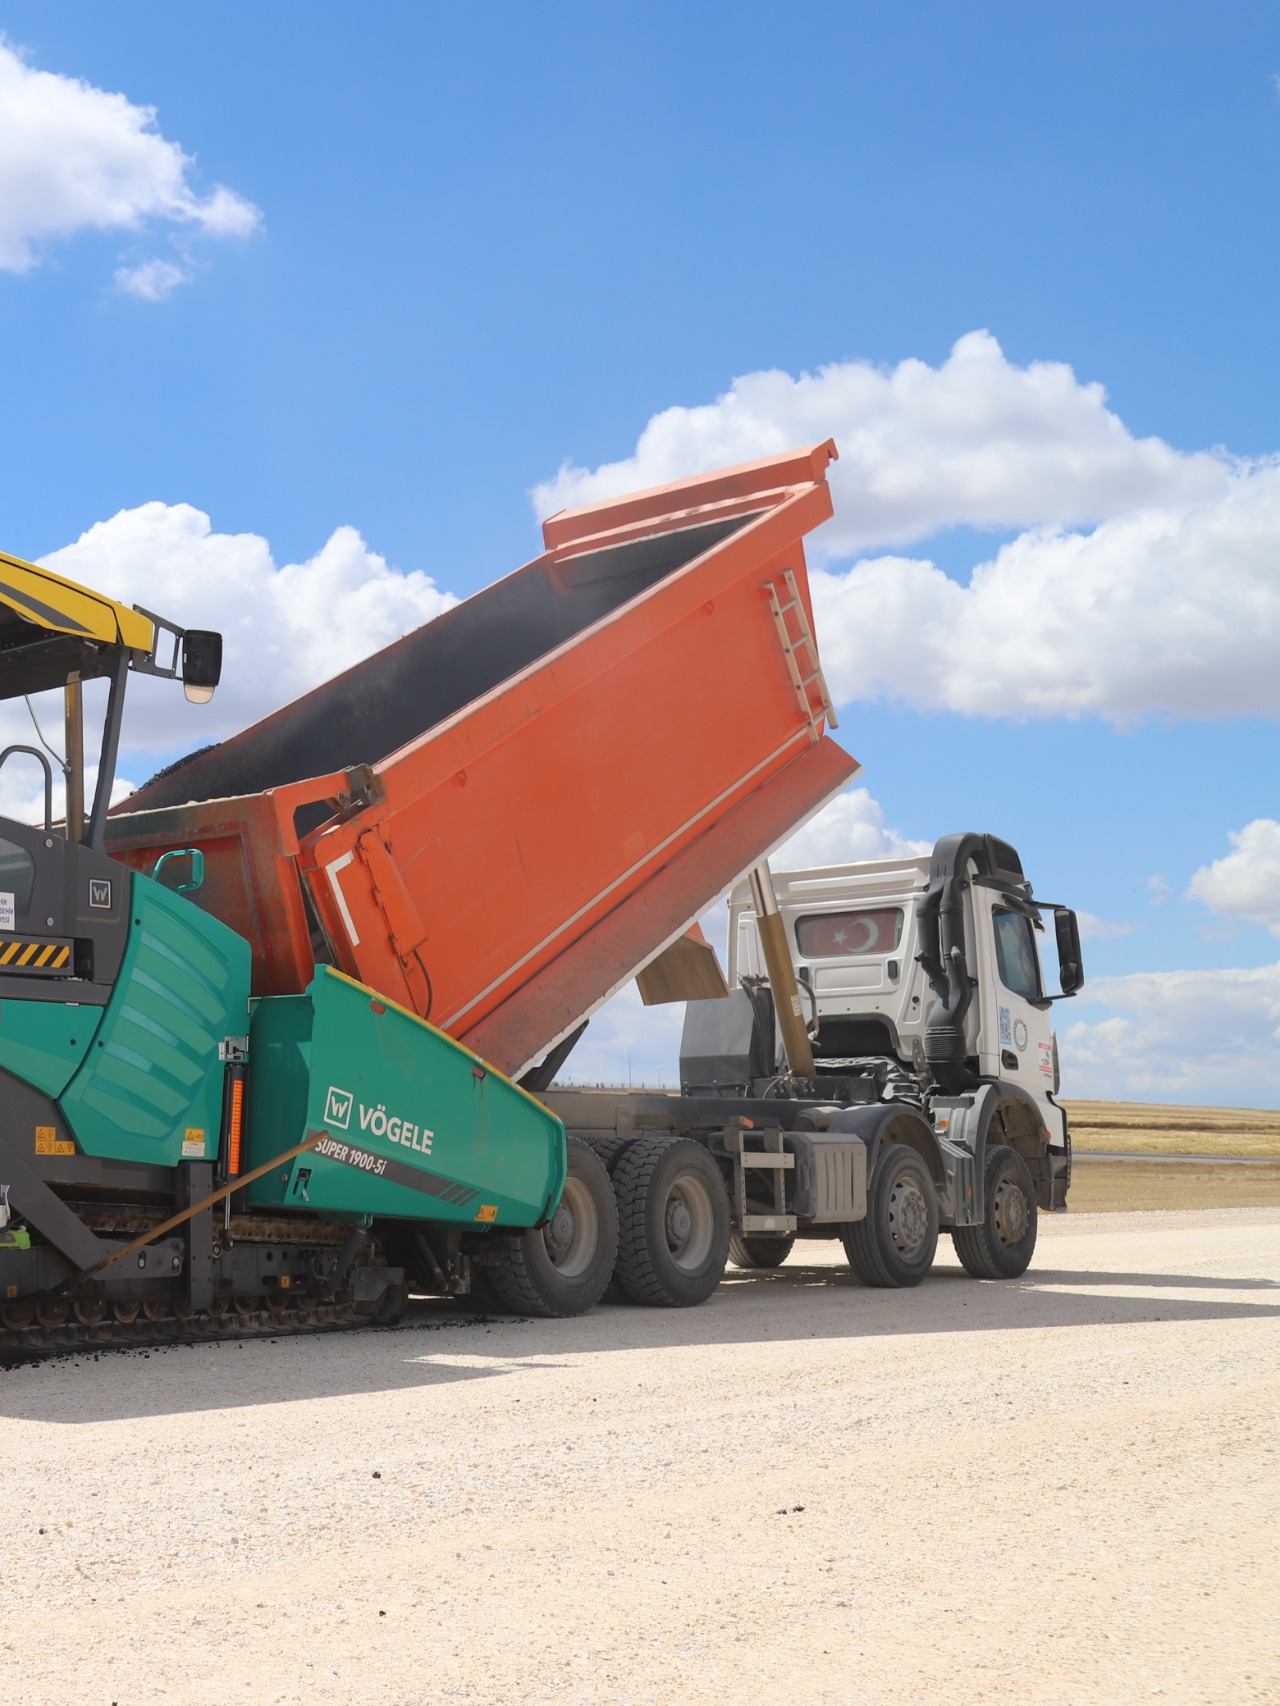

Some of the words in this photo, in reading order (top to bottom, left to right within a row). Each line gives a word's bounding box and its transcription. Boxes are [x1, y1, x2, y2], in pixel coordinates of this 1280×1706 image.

[359, 1103, 434, 1156] VÖGELE
[314, 1138, 350, 1162] SUPER
[348, 1148, 388, 1176] 1900-5i
